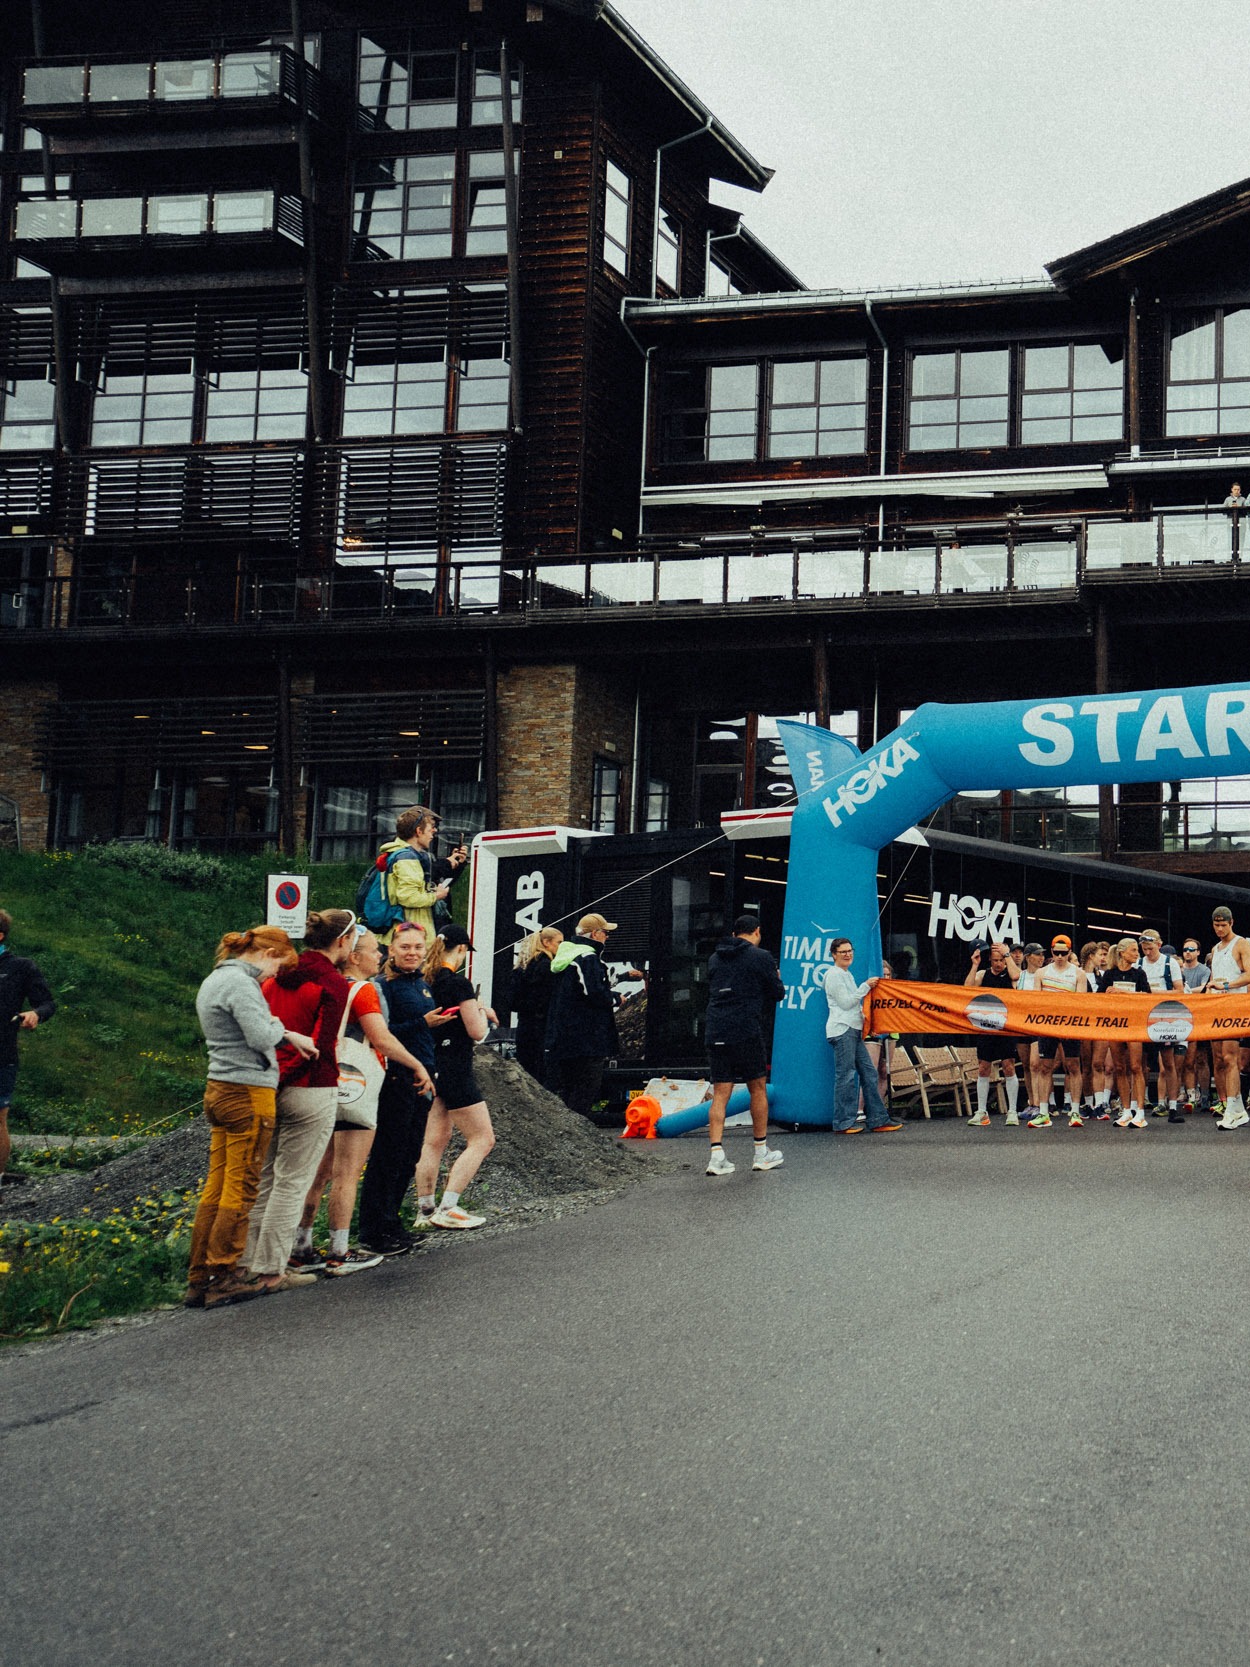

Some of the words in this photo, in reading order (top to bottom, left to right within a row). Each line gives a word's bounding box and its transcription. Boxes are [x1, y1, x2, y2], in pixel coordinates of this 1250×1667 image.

[821, 737, 920, 829] HOKA
[927, 891, 1021, 945] HOKA
[784, 936, 834, 962] TIME
[870, 999, 914, 1009] REFJELL
[1024, 1014, 1091, 1027] NOREFJELL
[1095, 1017, 1129, 1028] TRAIL
